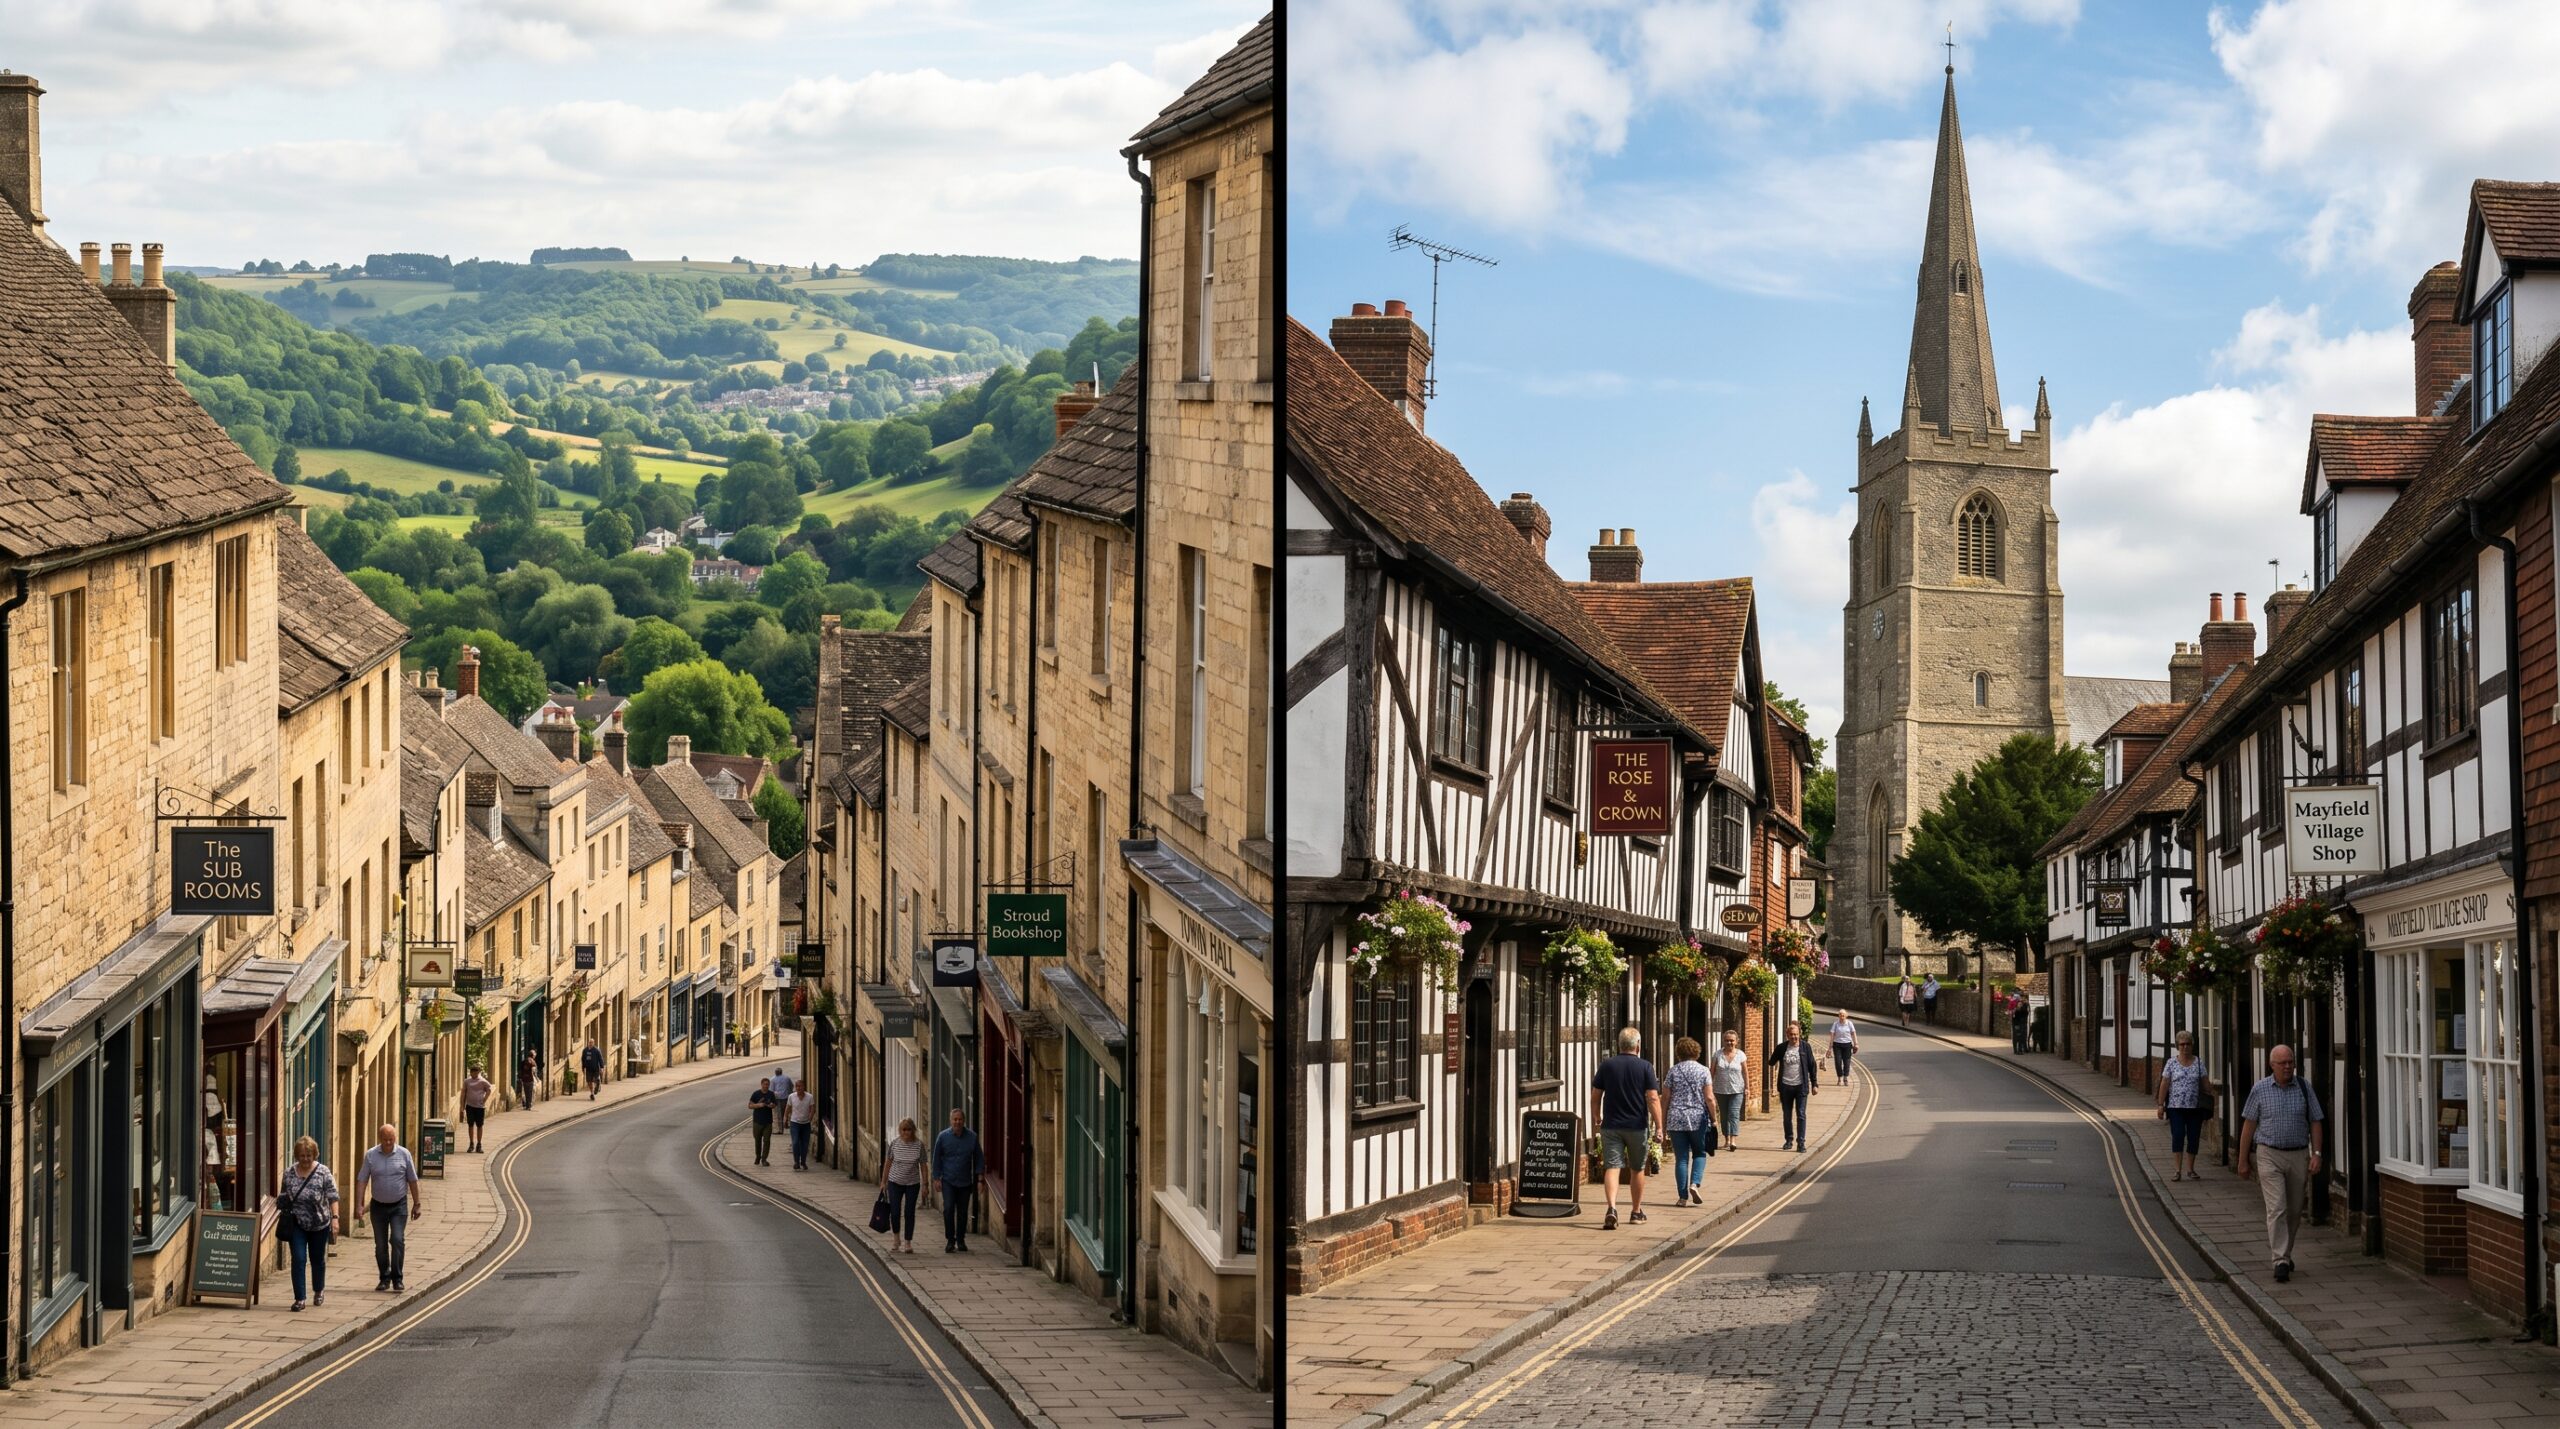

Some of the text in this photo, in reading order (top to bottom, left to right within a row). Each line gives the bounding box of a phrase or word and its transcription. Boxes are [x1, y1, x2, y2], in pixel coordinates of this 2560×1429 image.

[1614, 752, 1648, 767] THE
[1608, 770, 1653, 785] ROSE
[1623, 789, 1637, 803] &
[1598, 806, 1662, 821] CROWN
[2294, 800, 2370, 820] Mayfield
[2303, 823, 2365, 844] Village
[203, 840, 241, 858] The
[2312, 845, 2357, 865] Shop
[203, 861, 243, 879] SUB
[184, 882, 262, 899] ROOMS
[1003, 909, 1050, 922] Stroud
[2426, 899, 2462, 932] VILLAGE
[2462, 893, 2488, 924] SHOP
[992, 925, 1062, 942] Bookshop
[1210, 932, 1236, 979] HALL
